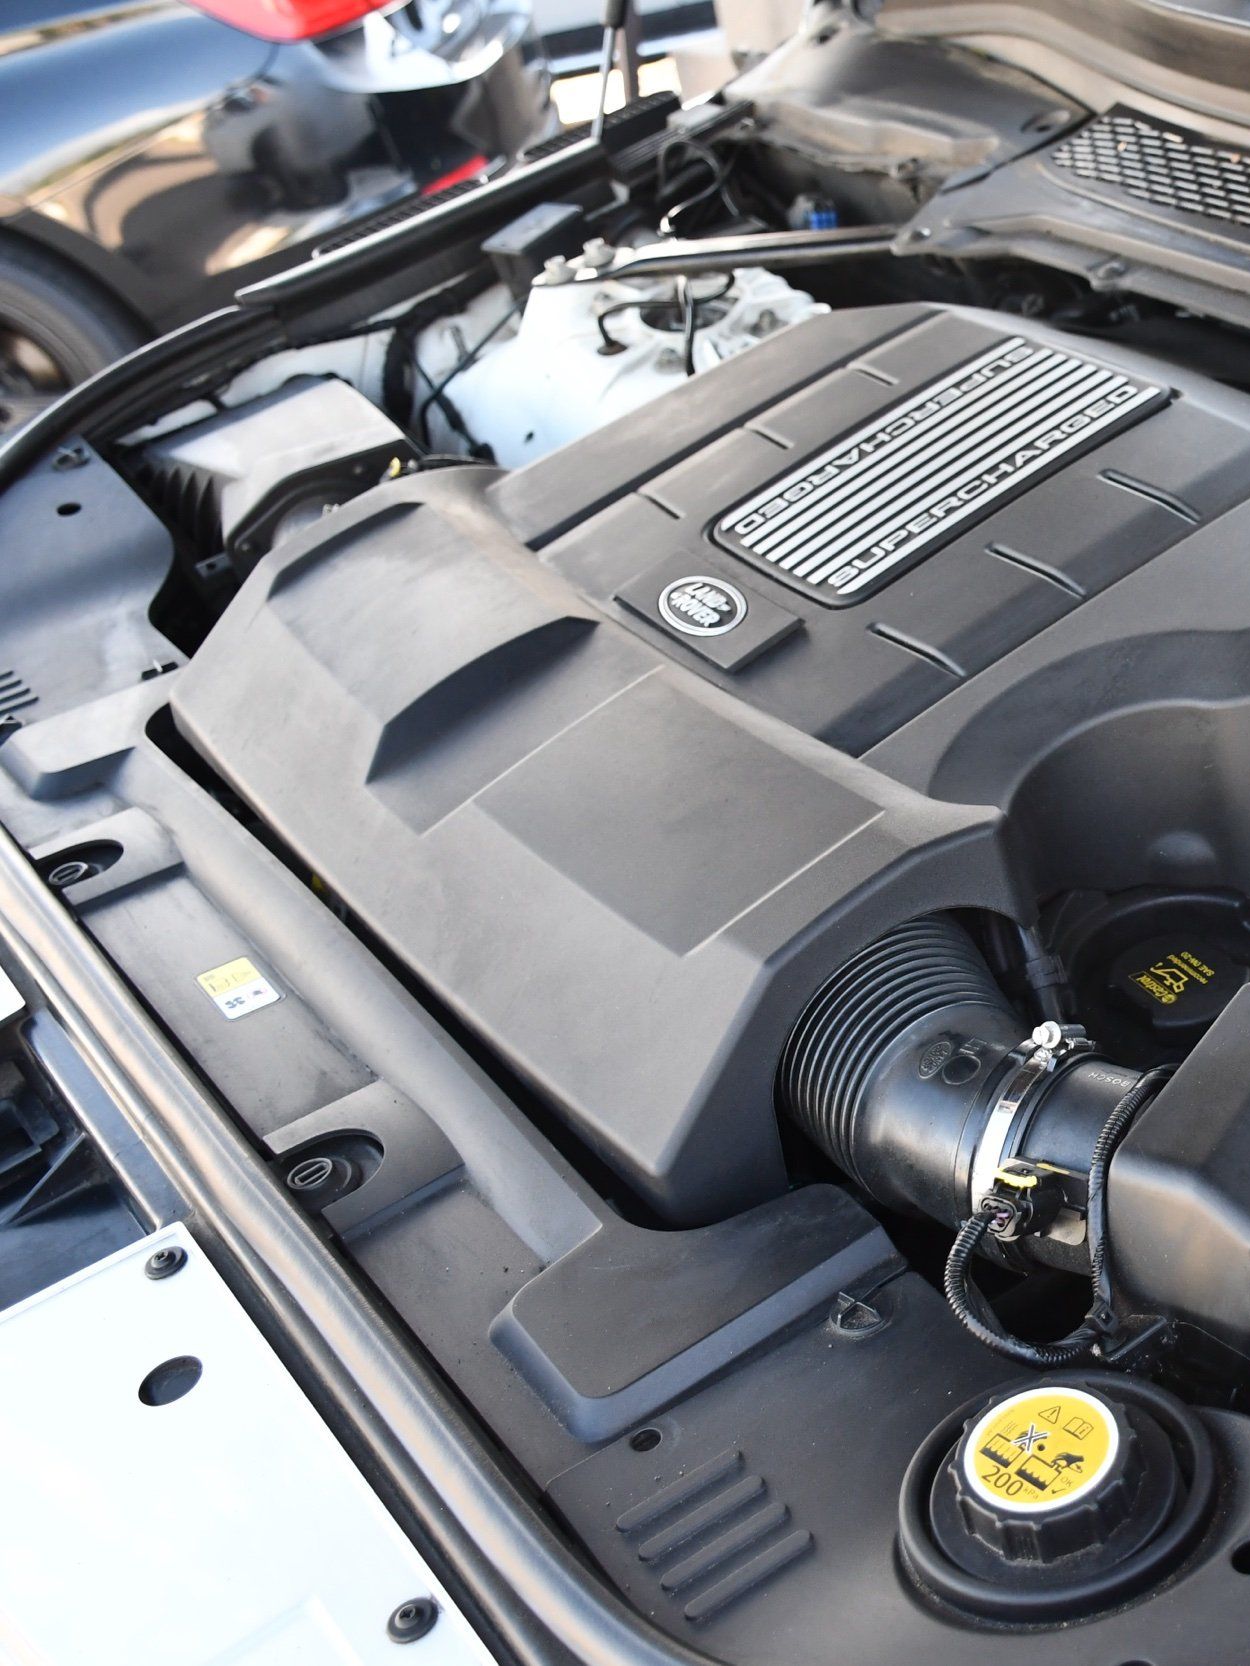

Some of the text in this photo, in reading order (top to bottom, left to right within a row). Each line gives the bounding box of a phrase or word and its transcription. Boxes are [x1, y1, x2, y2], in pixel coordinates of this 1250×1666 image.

[734, 346, 1034, 535] SUPERCHARGED
[827, 384, 1139, 587] SUPERCHARGED
[684, 583, 728, 609] LAND
[670, 594, 721, 628] ROVER
[1136, 975, 1169, 997] Castrol
[1088, 1072, 1132, 1088] BOSCH
[981, 1464, 1024, 1497] 200
[1060, 1475, 1073, 1487] OK
